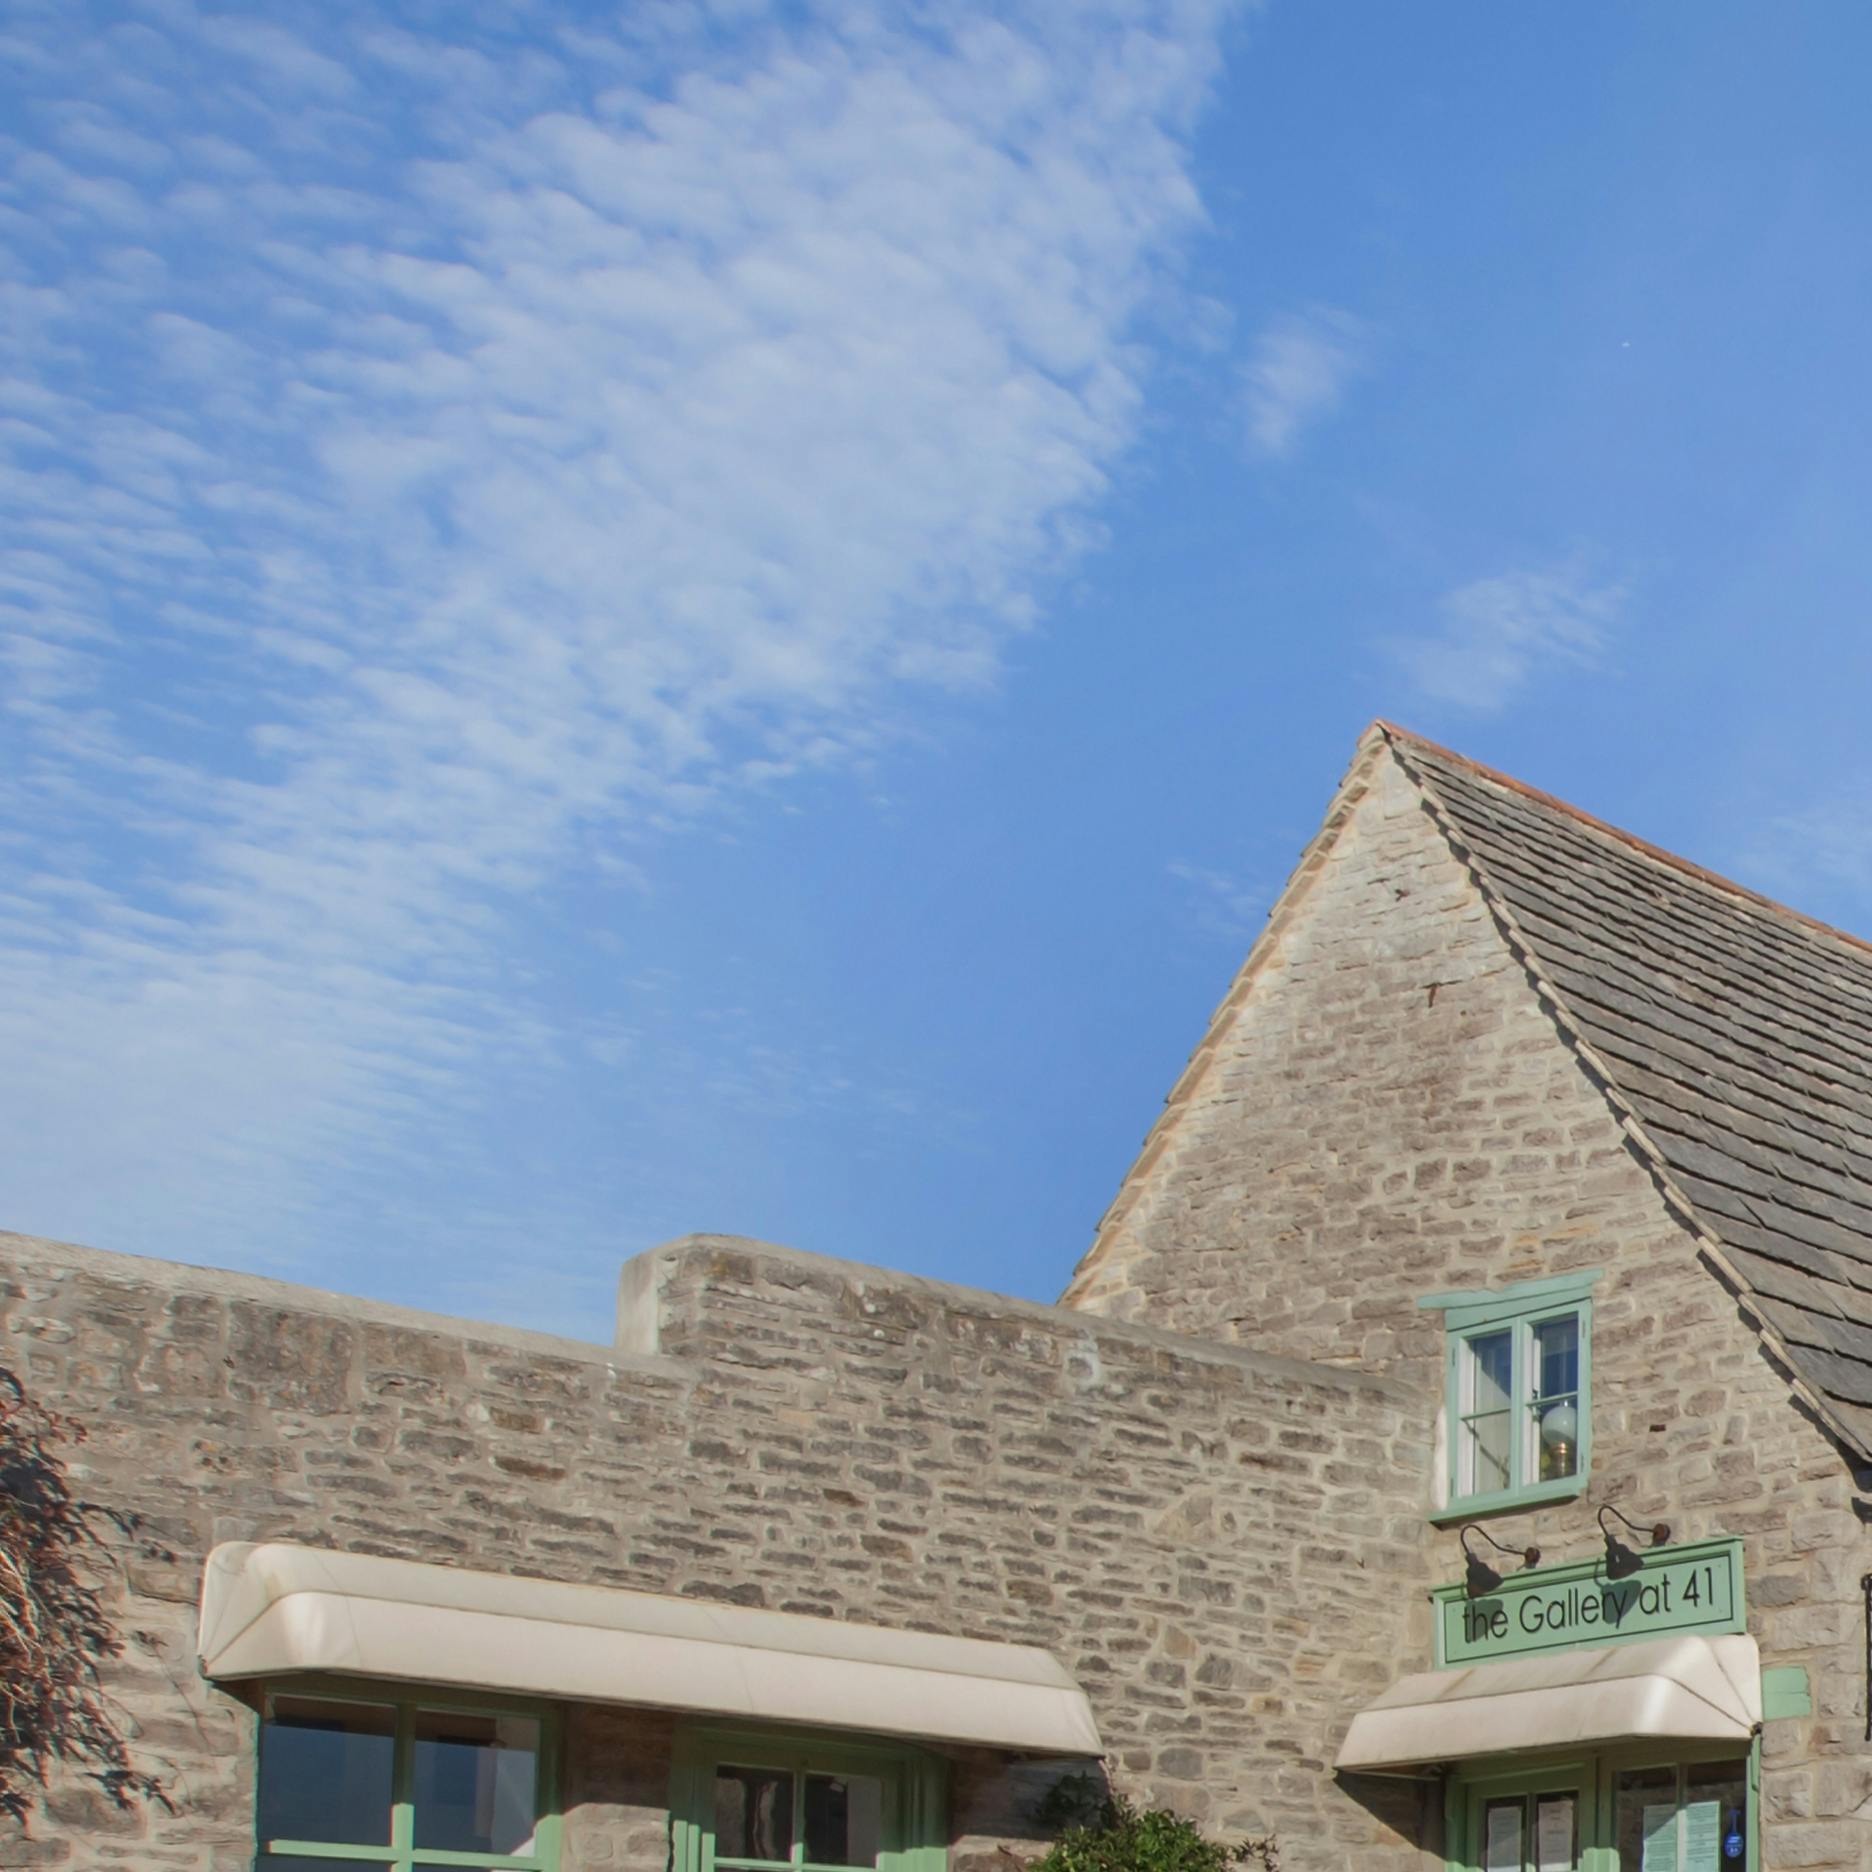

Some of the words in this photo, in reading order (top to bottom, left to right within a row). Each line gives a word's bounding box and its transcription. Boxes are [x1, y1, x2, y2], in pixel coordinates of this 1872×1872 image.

[1462, 1604, 1508, 1644] the
[1519, 1588, 1630, 1633] Gallery
[1639, 1573, 1671, 1615] at
[1682, 1567, 1714, 1607] 41
